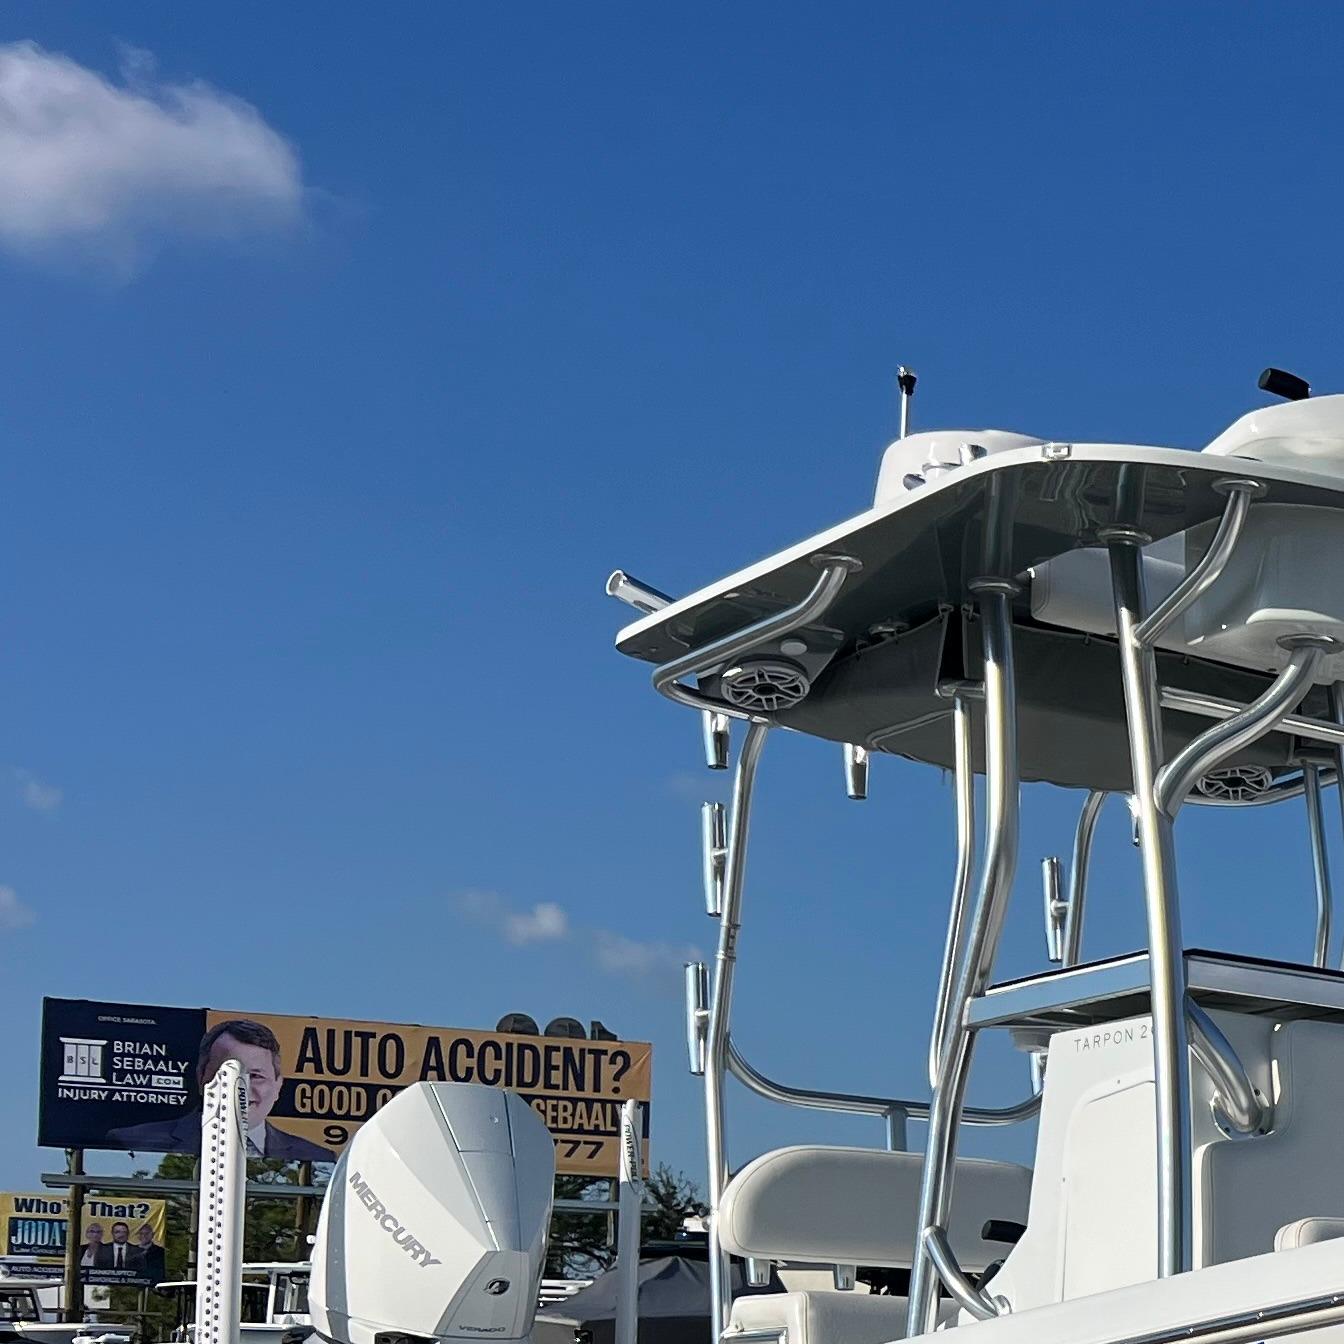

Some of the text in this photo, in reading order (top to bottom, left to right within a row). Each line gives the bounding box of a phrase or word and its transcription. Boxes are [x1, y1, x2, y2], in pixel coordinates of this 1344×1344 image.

[113, 1040, 166, 1056] BRIAN
[1073, 1024, 1153, 1053] TARPON 2
[112, 1056, 189, 1073] SEBAALY
[295, 1026, 631, 1095] AUTO ACCIDENT?
[112, 1071, 150, 1086] LAW
[58, 1087, 188, 1105] INJURY ATTORNEY
[295, 1083, 368, 1117] GOOD
[531, 1098, 622, 1132] SEBAAL
[14, 1197, 149, 1219] Who' That?
[349, 1171, 442, 1268] MERCURY
[11, 1219, 67, 1246] JODA
